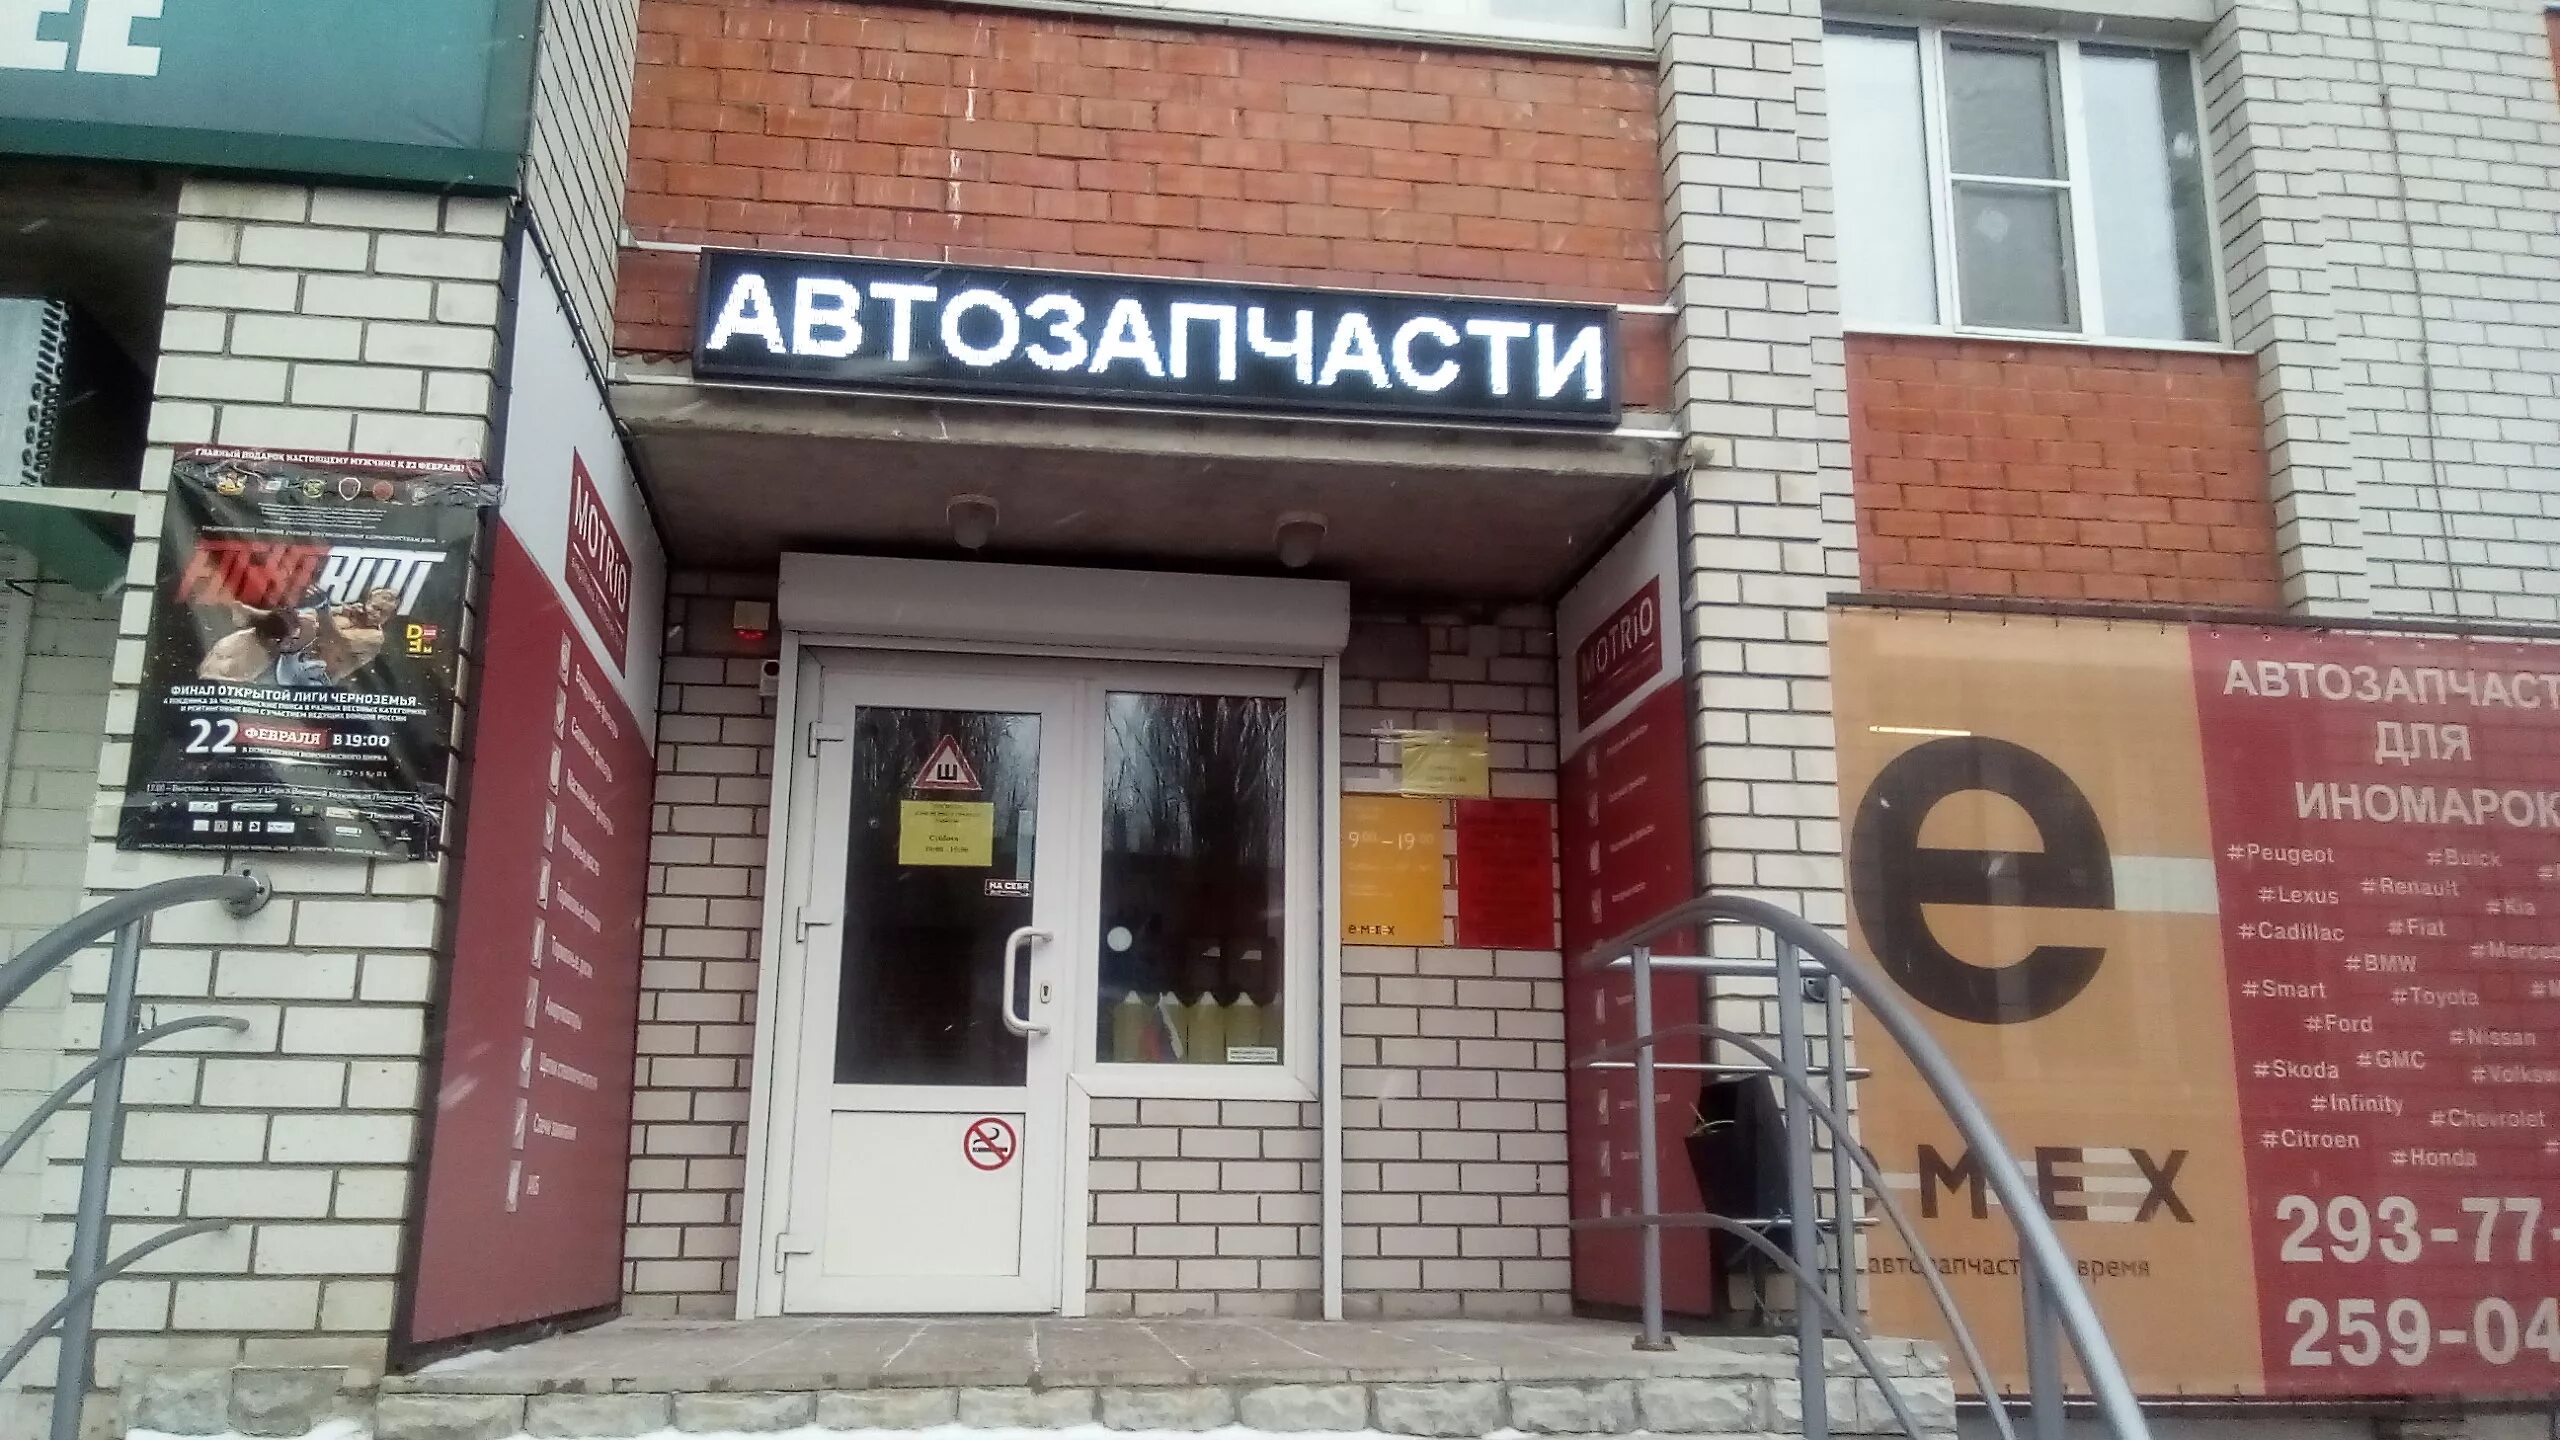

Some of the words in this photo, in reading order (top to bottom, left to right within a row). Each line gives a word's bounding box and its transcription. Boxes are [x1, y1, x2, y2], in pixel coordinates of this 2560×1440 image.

[705, 273, 1602, 400] АВТОЗАПЧАСТИ
[171, 686, 215, 697] ФИНАЛ
[218, 685, 292, 702] ОТКРЫТОЙ
[293, 690, 328, 704] ЛИГИ
[186, 718, 239, 754] 22
[244, 728, 321, 745] ФЕВРАЛЯ
[346, 734, 390, 747] 19:00
[2375, 720, 2472, 766] ДЛЯ
[937, 763, 958, 780] Ш
[2226, 843, 2336, 867] #Peugeot
[2258, 886, 2340, 905] #Lexus
[2360, 876, 2459, 897] #Renault
[2238, 921, 2345, 942] #Cadillac
[2387, 917, 2448, 937] #Fiat
[2345, 953, 2417, 973] #BMW
[2242, 979, 2328, 999] #Smart
[2391, 986, 2480, 1008] #Toyota
[2304, 1014, 2373, 1034] #Ford
[2450, 1027, 2537, 1046] #Nissan
[2253, 1059, 2340, 1080] #Skoda
[2356, 1050, 2426, 1069] #GMC
[2310, 1094, 2404, 1116] #Infinity
[2429, 1108, 2547, 1129] #Chevrolet
[2261, 1128, 2360, 1149] #Citroen
[2392, 1149, 2478, 1167] #Honda
[2276, 1194, 2560, 1263] 293-77
